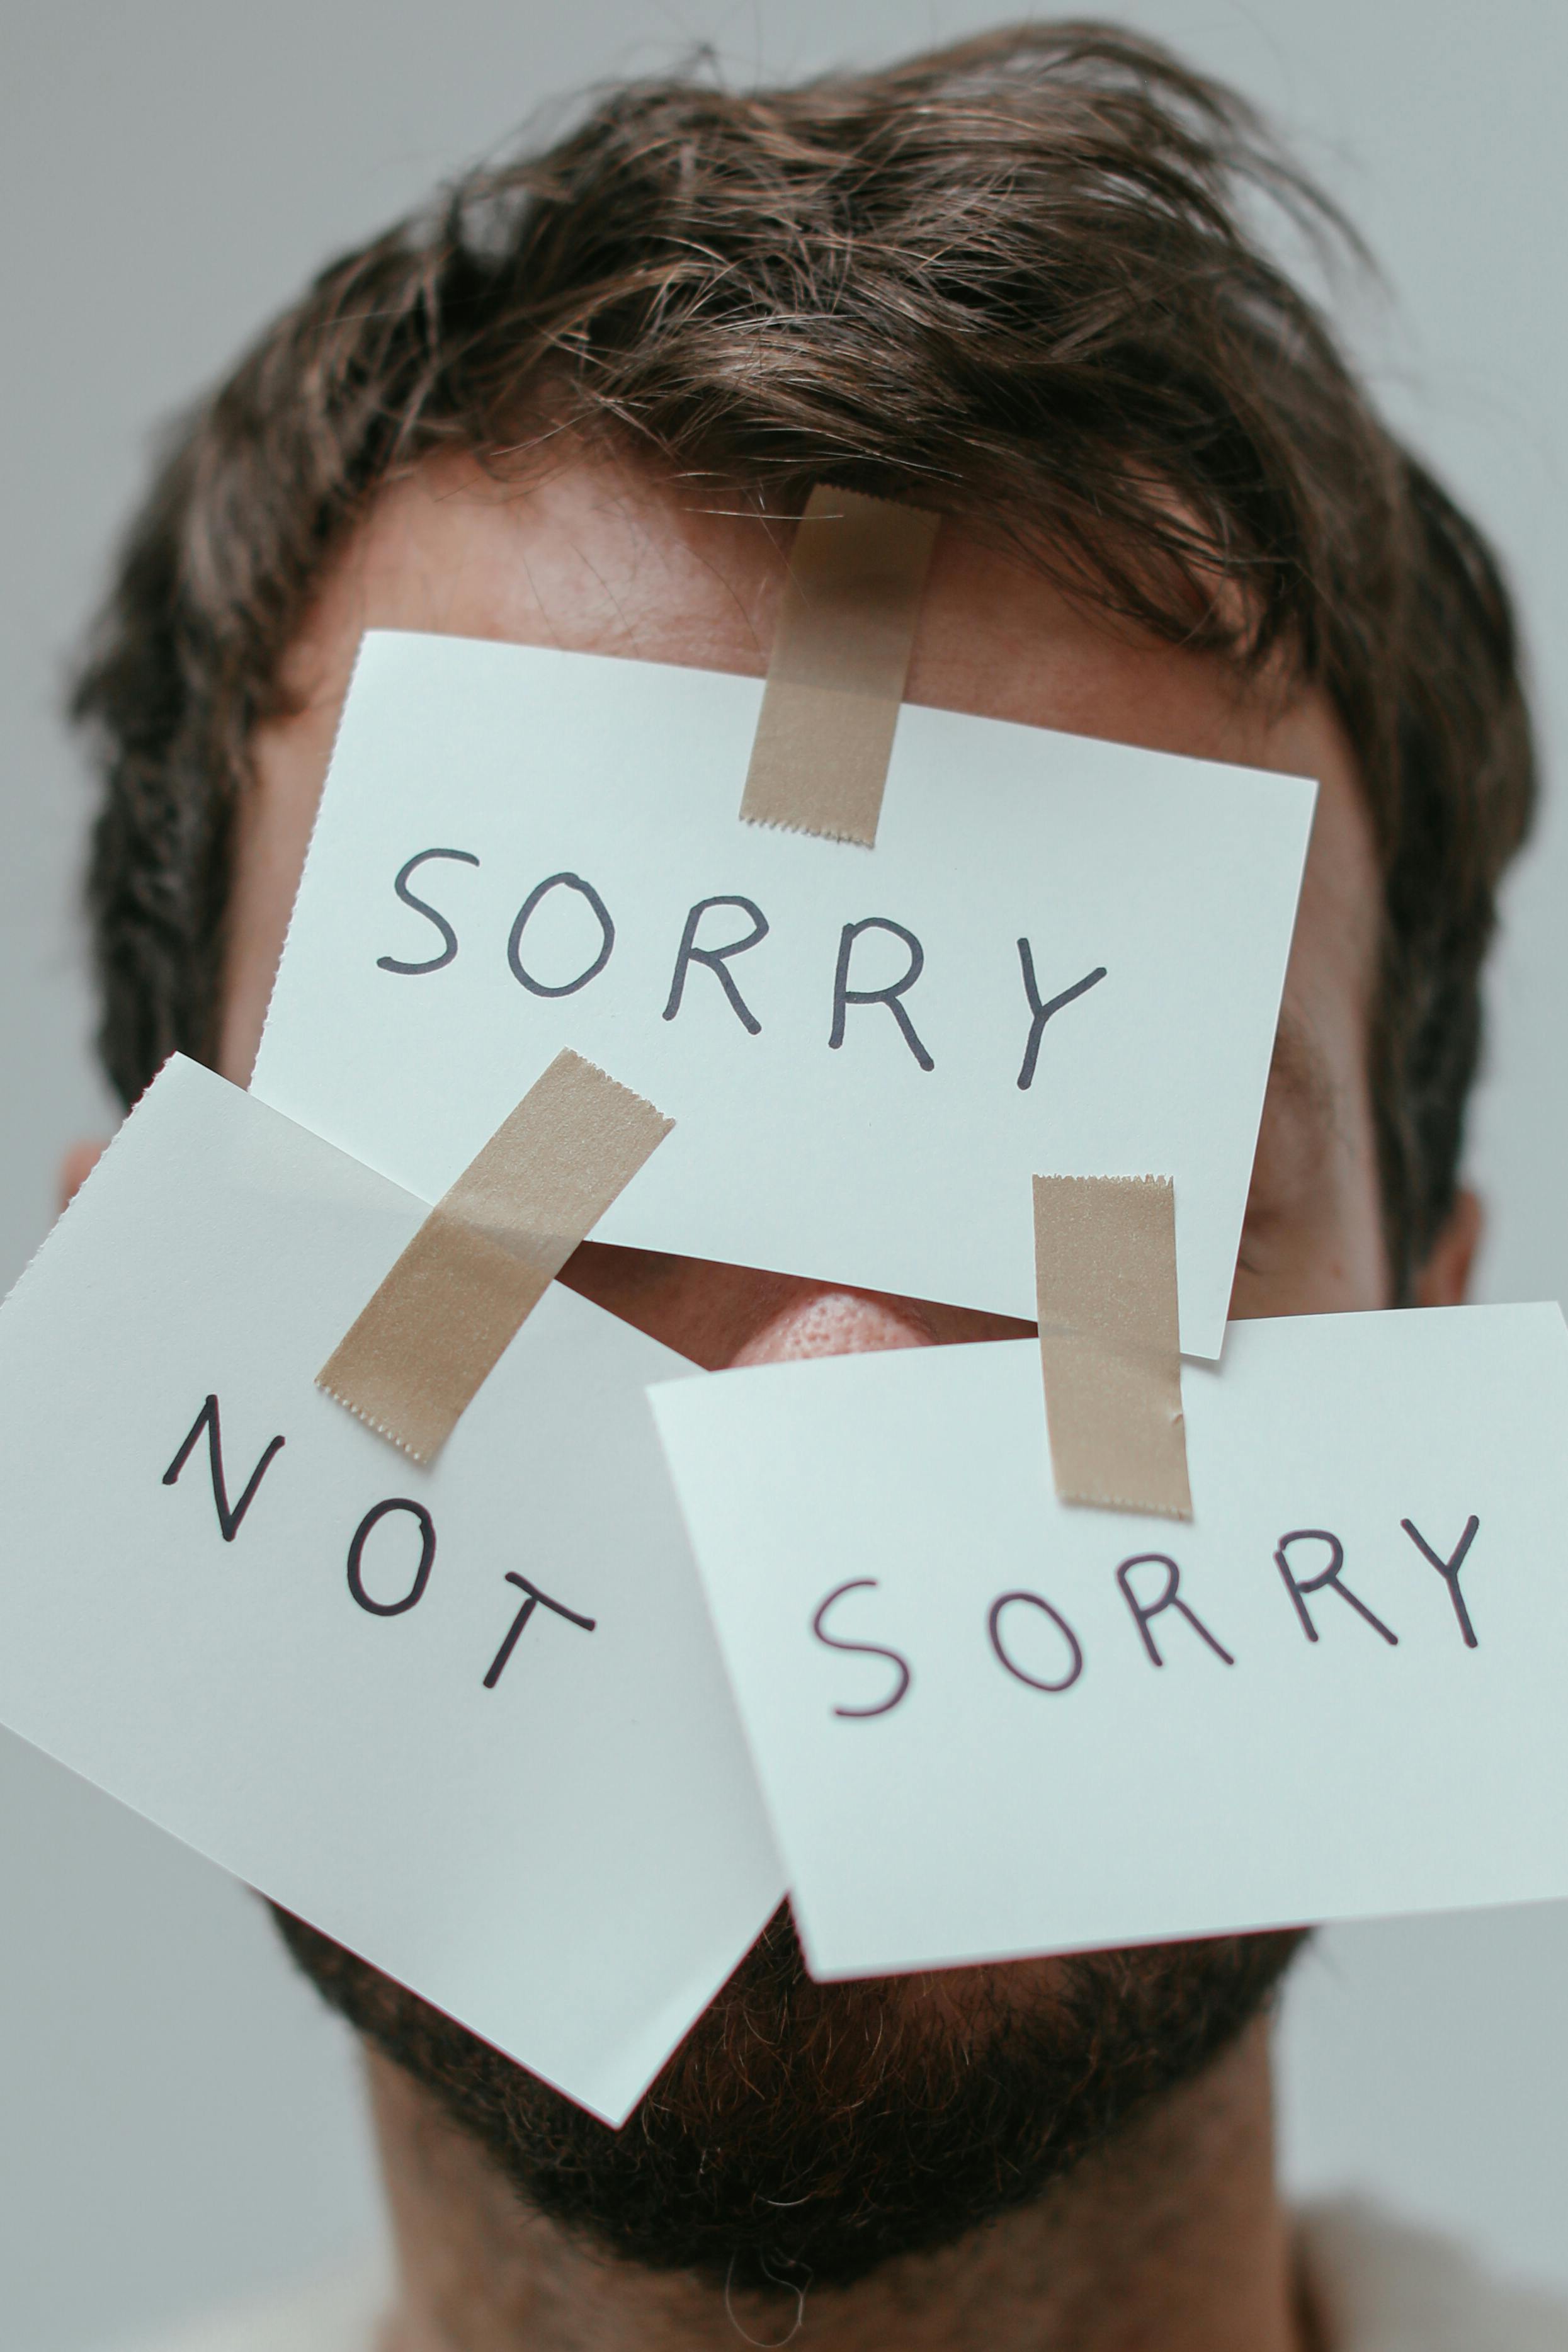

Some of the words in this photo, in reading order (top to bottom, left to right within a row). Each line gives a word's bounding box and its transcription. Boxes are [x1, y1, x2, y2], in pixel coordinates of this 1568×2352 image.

[376, 848, 1108, 1091] SORRY
[162, 1394, 597, 1689] NOT
[812, 1514, 1481, 1719] SORRY
